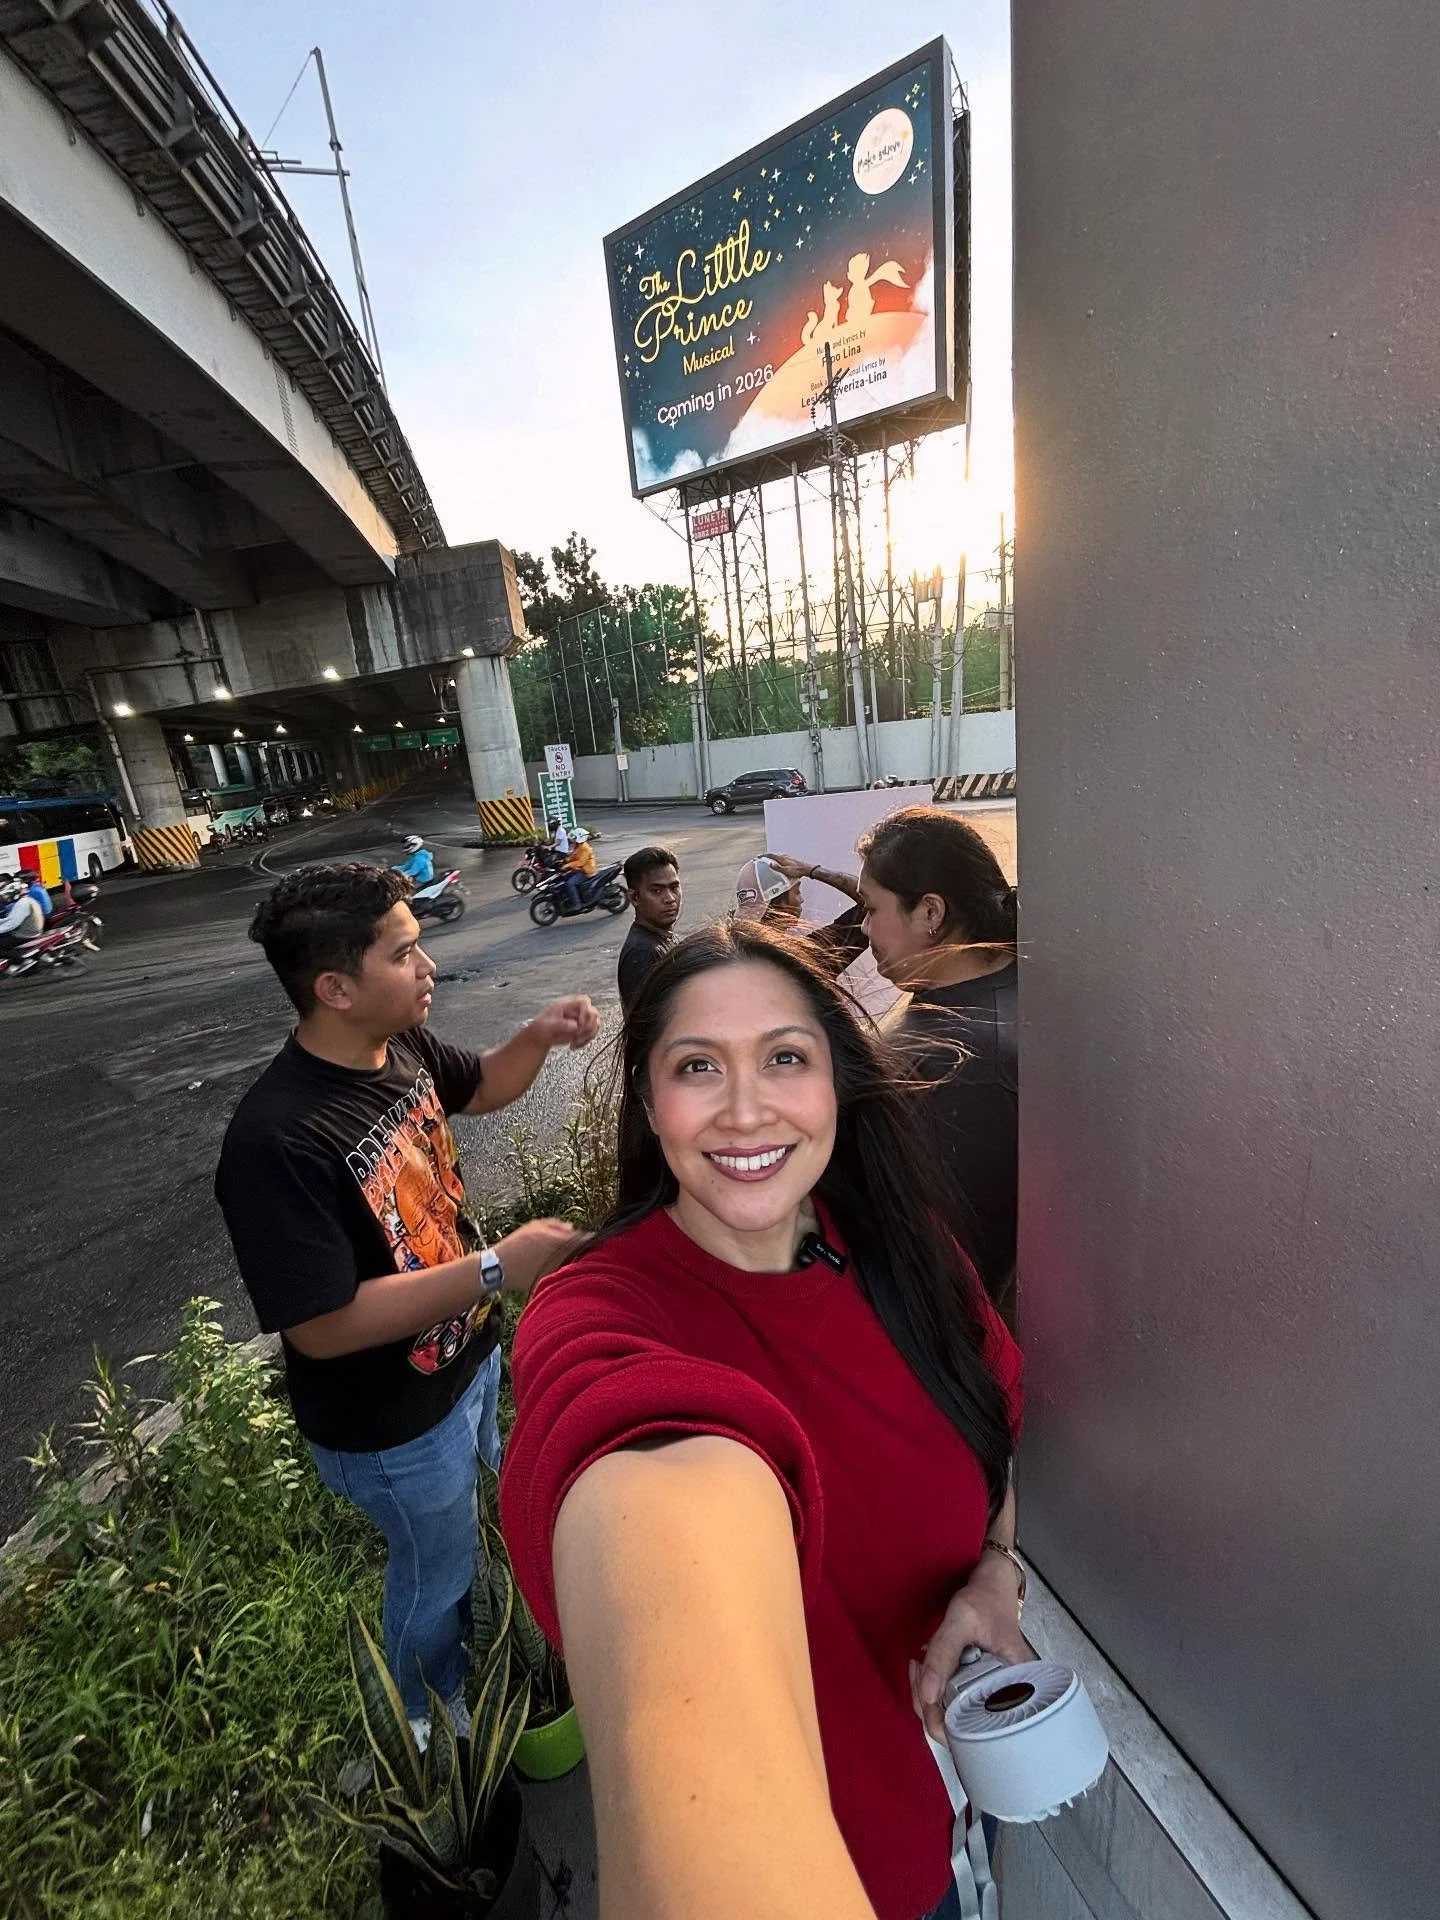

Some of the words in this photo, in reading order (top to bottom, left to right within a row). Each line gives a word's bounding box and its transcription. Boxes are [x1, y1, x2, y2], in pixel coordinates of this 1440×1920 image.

[639, 270, 670, 300] The
[661, 218, 772, 317] Little
[634, 298, 753, 363] Prince
[843, 333, 859, 345] Lyrics
[859, 329, 867, 338] by
[683, 335, 735, 375] Musical
[843, 344, 861, 359] Lina
[861, 361, 878, 374] Lyrics
[878, 356, 886, 366] by
[657, 391, 715, 423] Coming
[717, 383, 732, 401] in
[735, 363, 774, 395] 2026
[693, 508, 727, 527] LUNETA
[551, 770, 571, 779] ENTRY
[555, 763, 565, 771] NO
